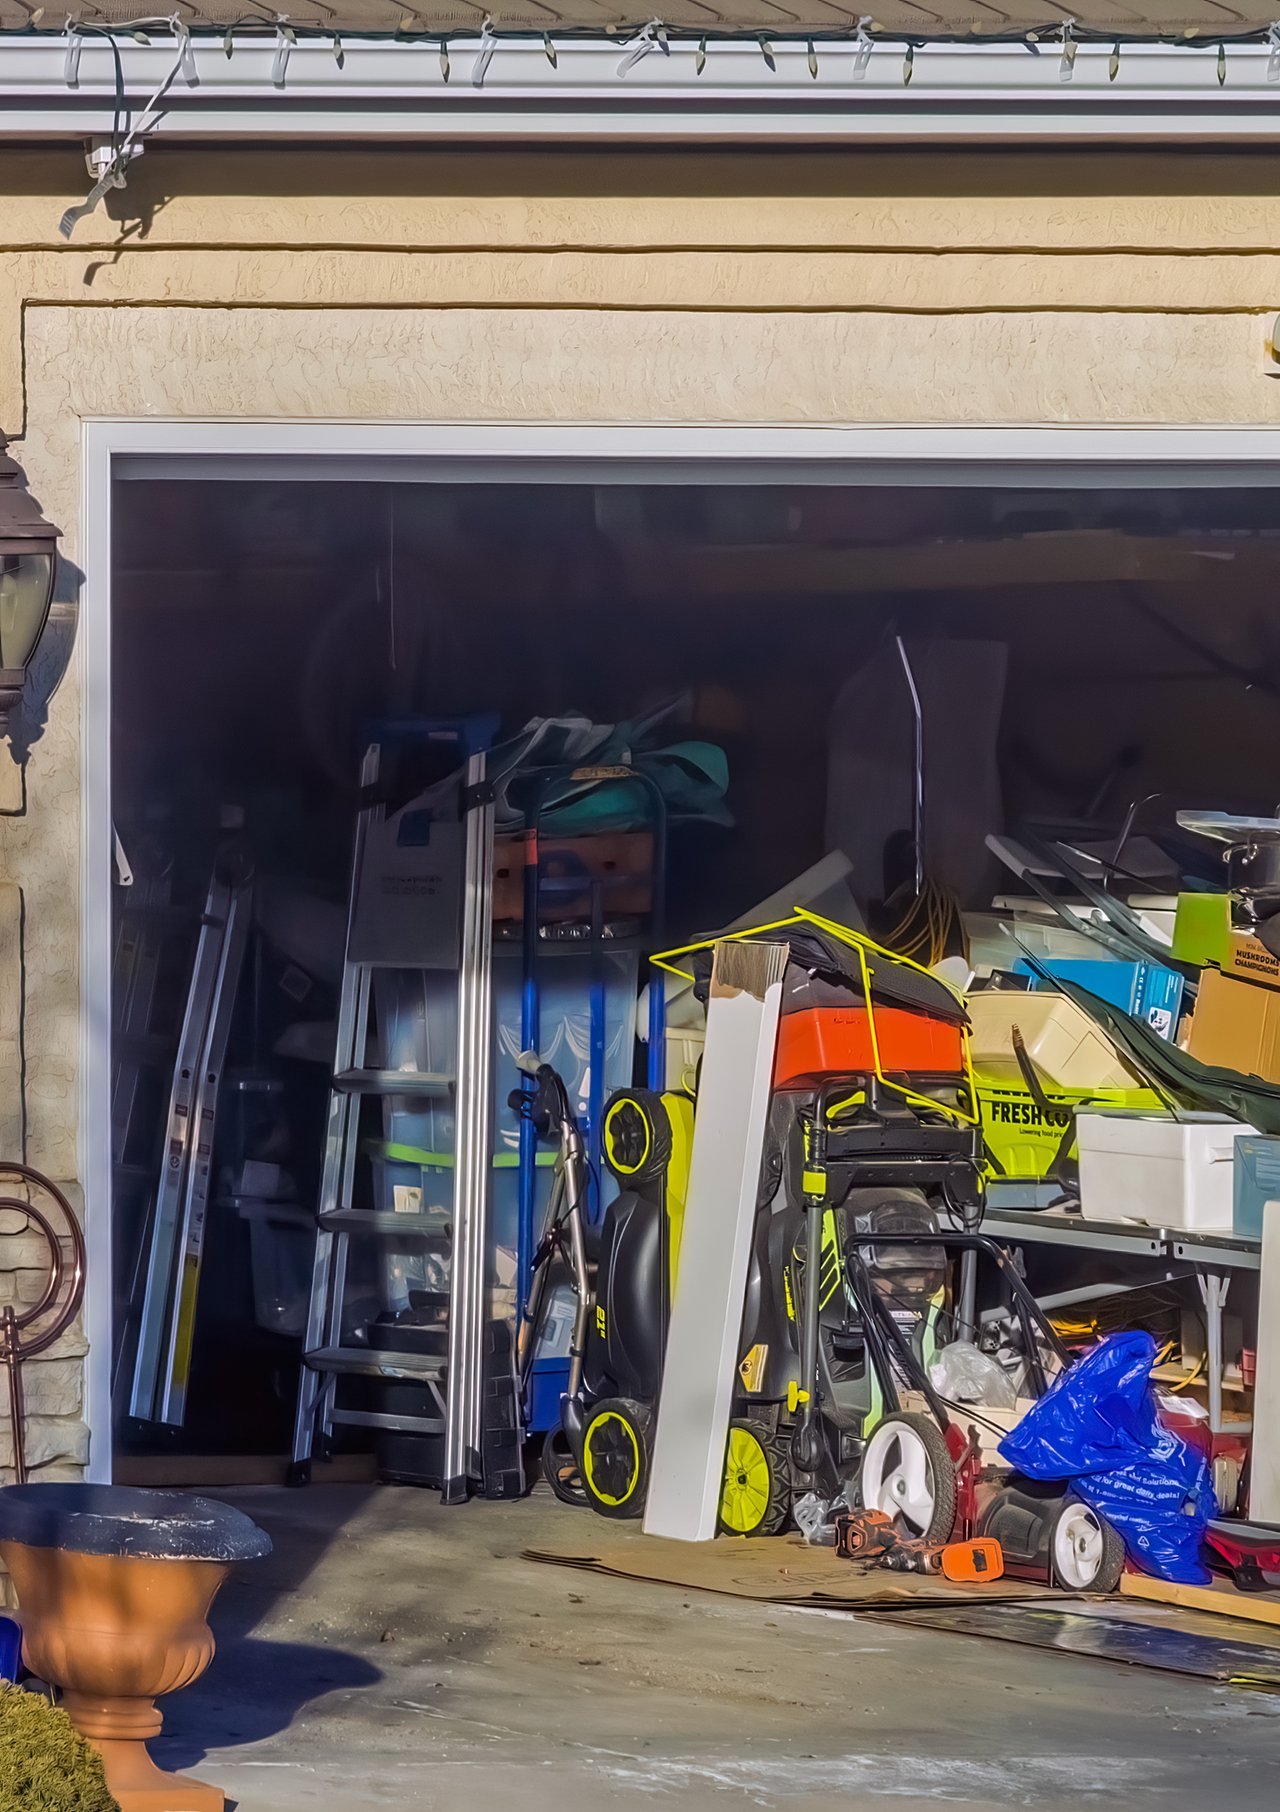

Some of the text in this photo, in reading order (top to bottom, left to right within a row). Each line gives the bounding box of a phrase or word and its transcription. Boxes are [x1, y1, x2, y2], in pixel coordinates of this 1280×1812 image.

[1236, 949, 1280, 967] MUSHROOMS
[1019, 1128, 1064, 1138] Lowering food pric
[1113, 1480, 1136, 1494] great
